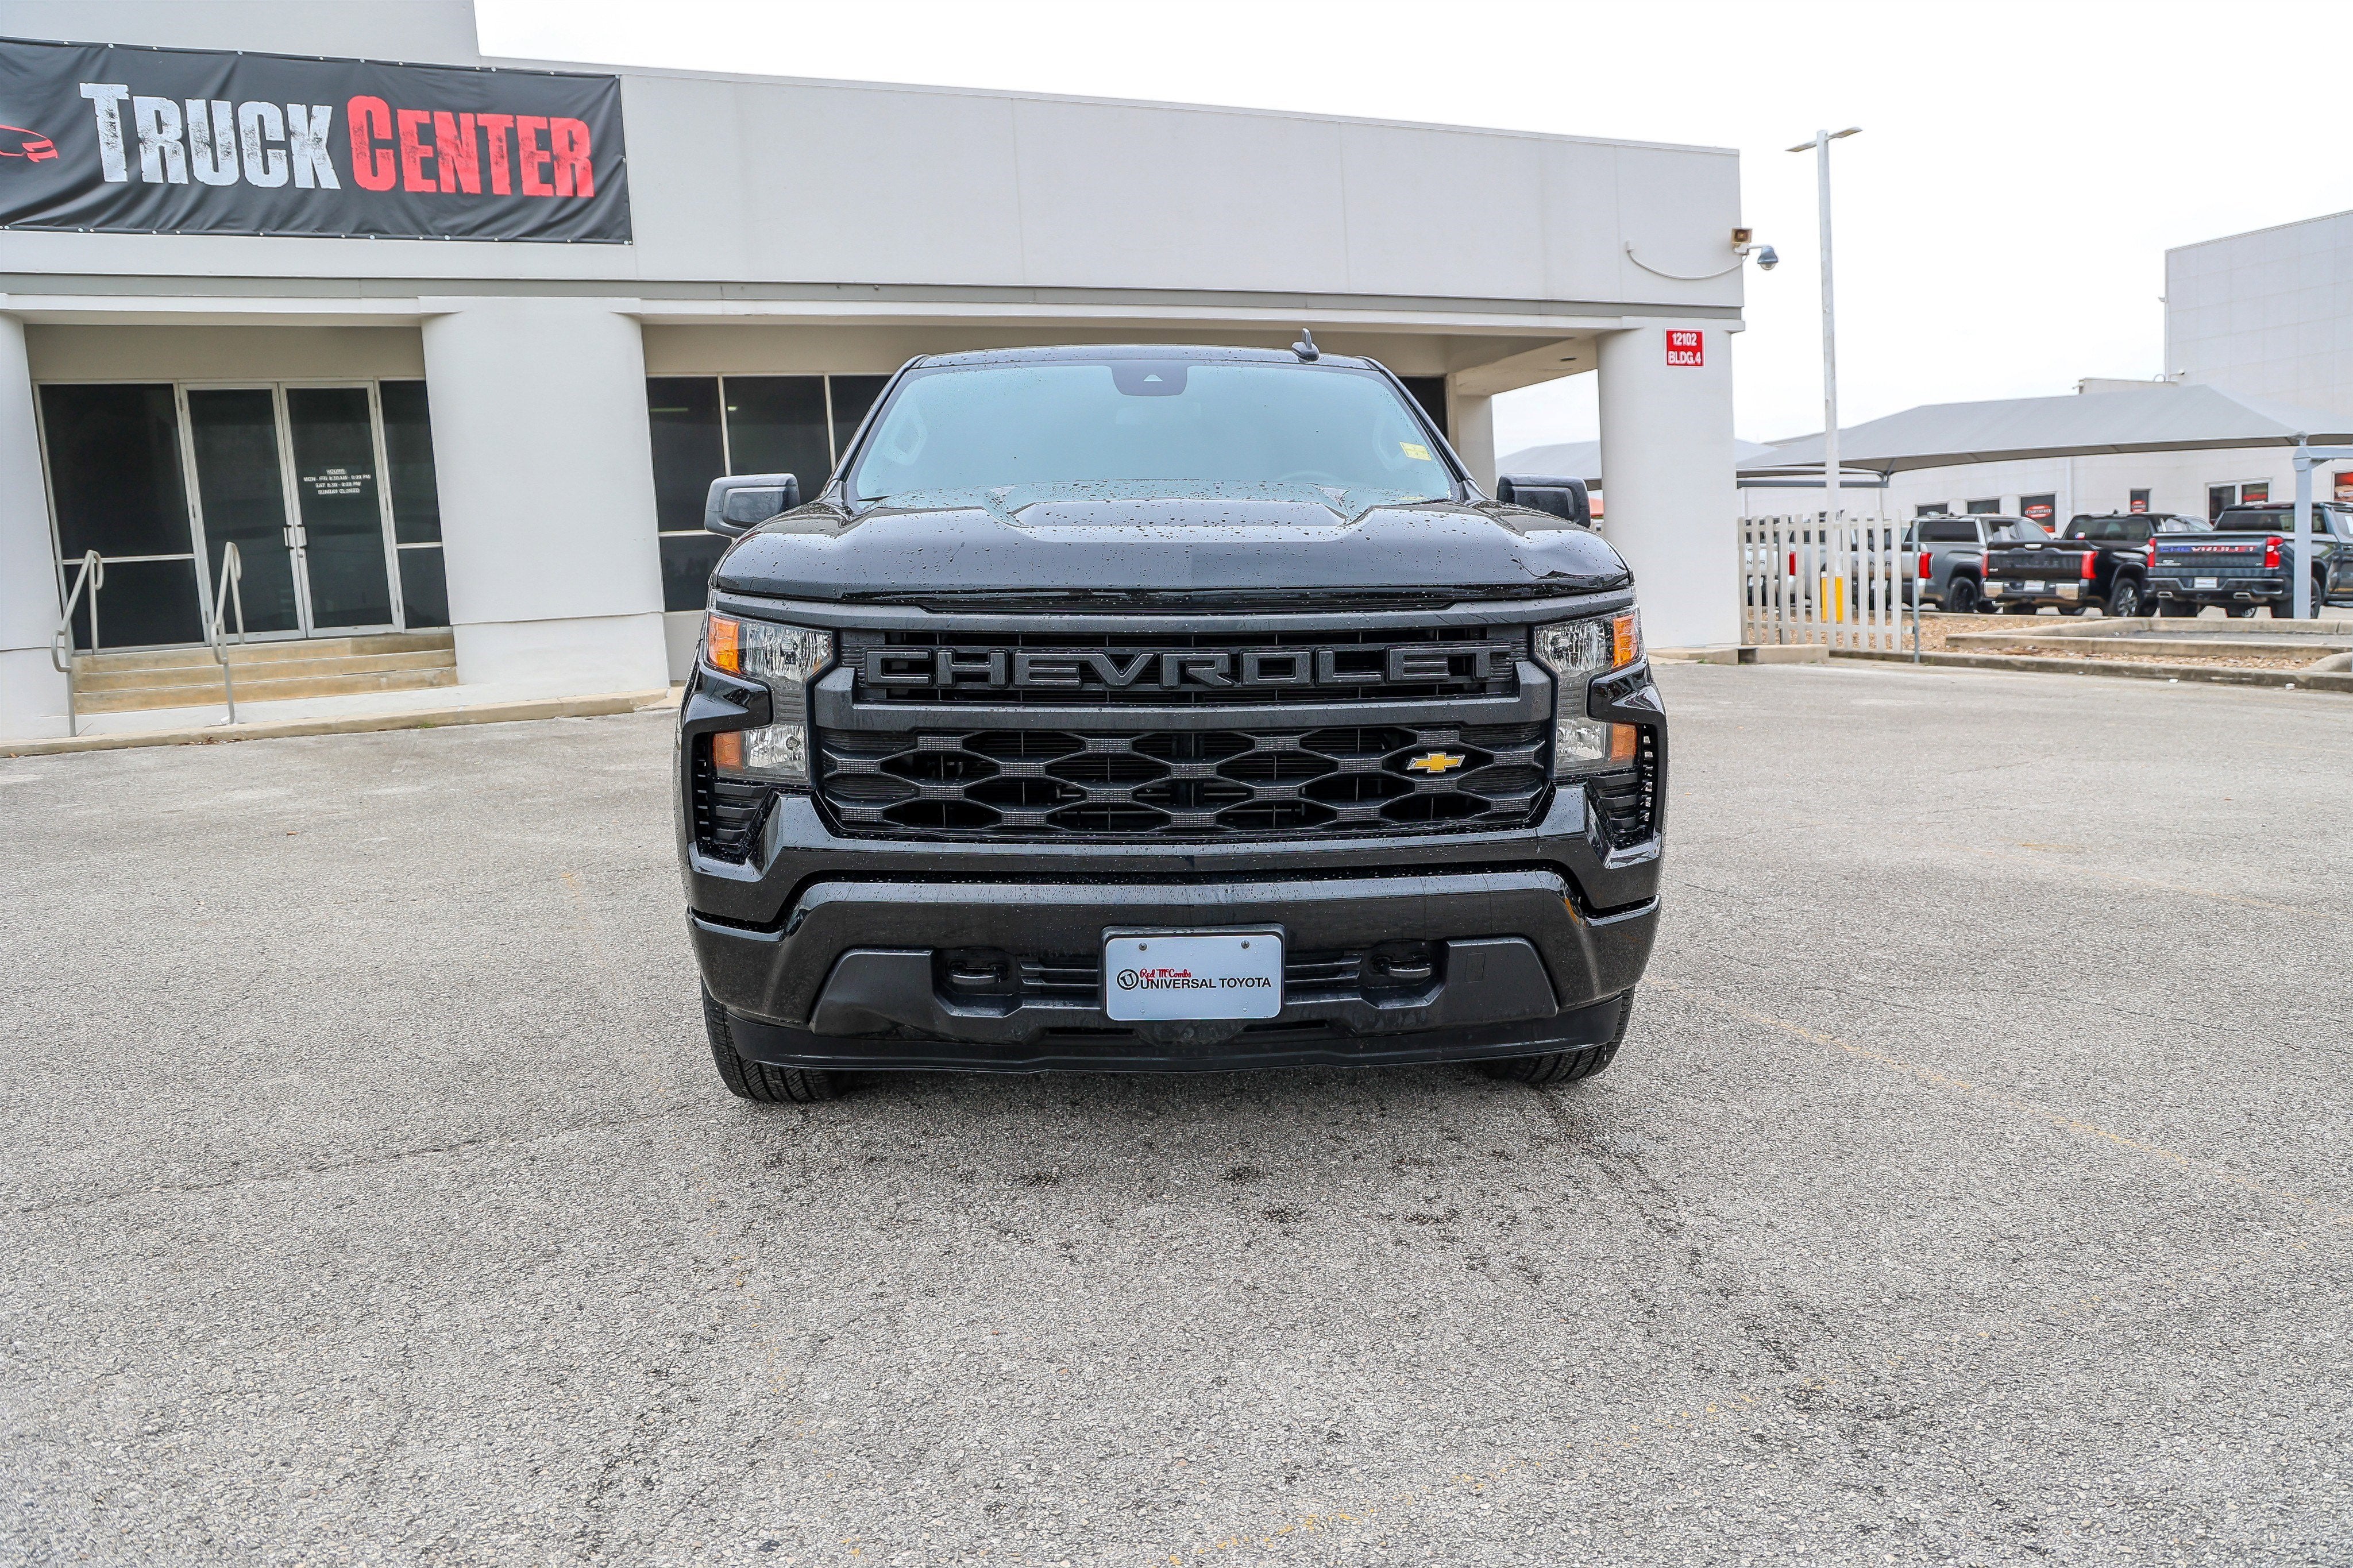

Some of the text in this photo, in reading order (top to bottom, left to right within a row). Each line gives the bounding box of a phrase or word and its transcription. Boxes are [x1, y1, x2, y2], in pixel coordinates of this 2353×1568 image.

[79, 82, 595, 198] TRUCK CENTER
[1672, 332, 1698, 346] 12102
[866, 643, 1511, 688] CHEVROLET
[1139, 968, 1156, 981] Red
[1140, 977, 1272, 990] UNIVERSAL TOYOTA
